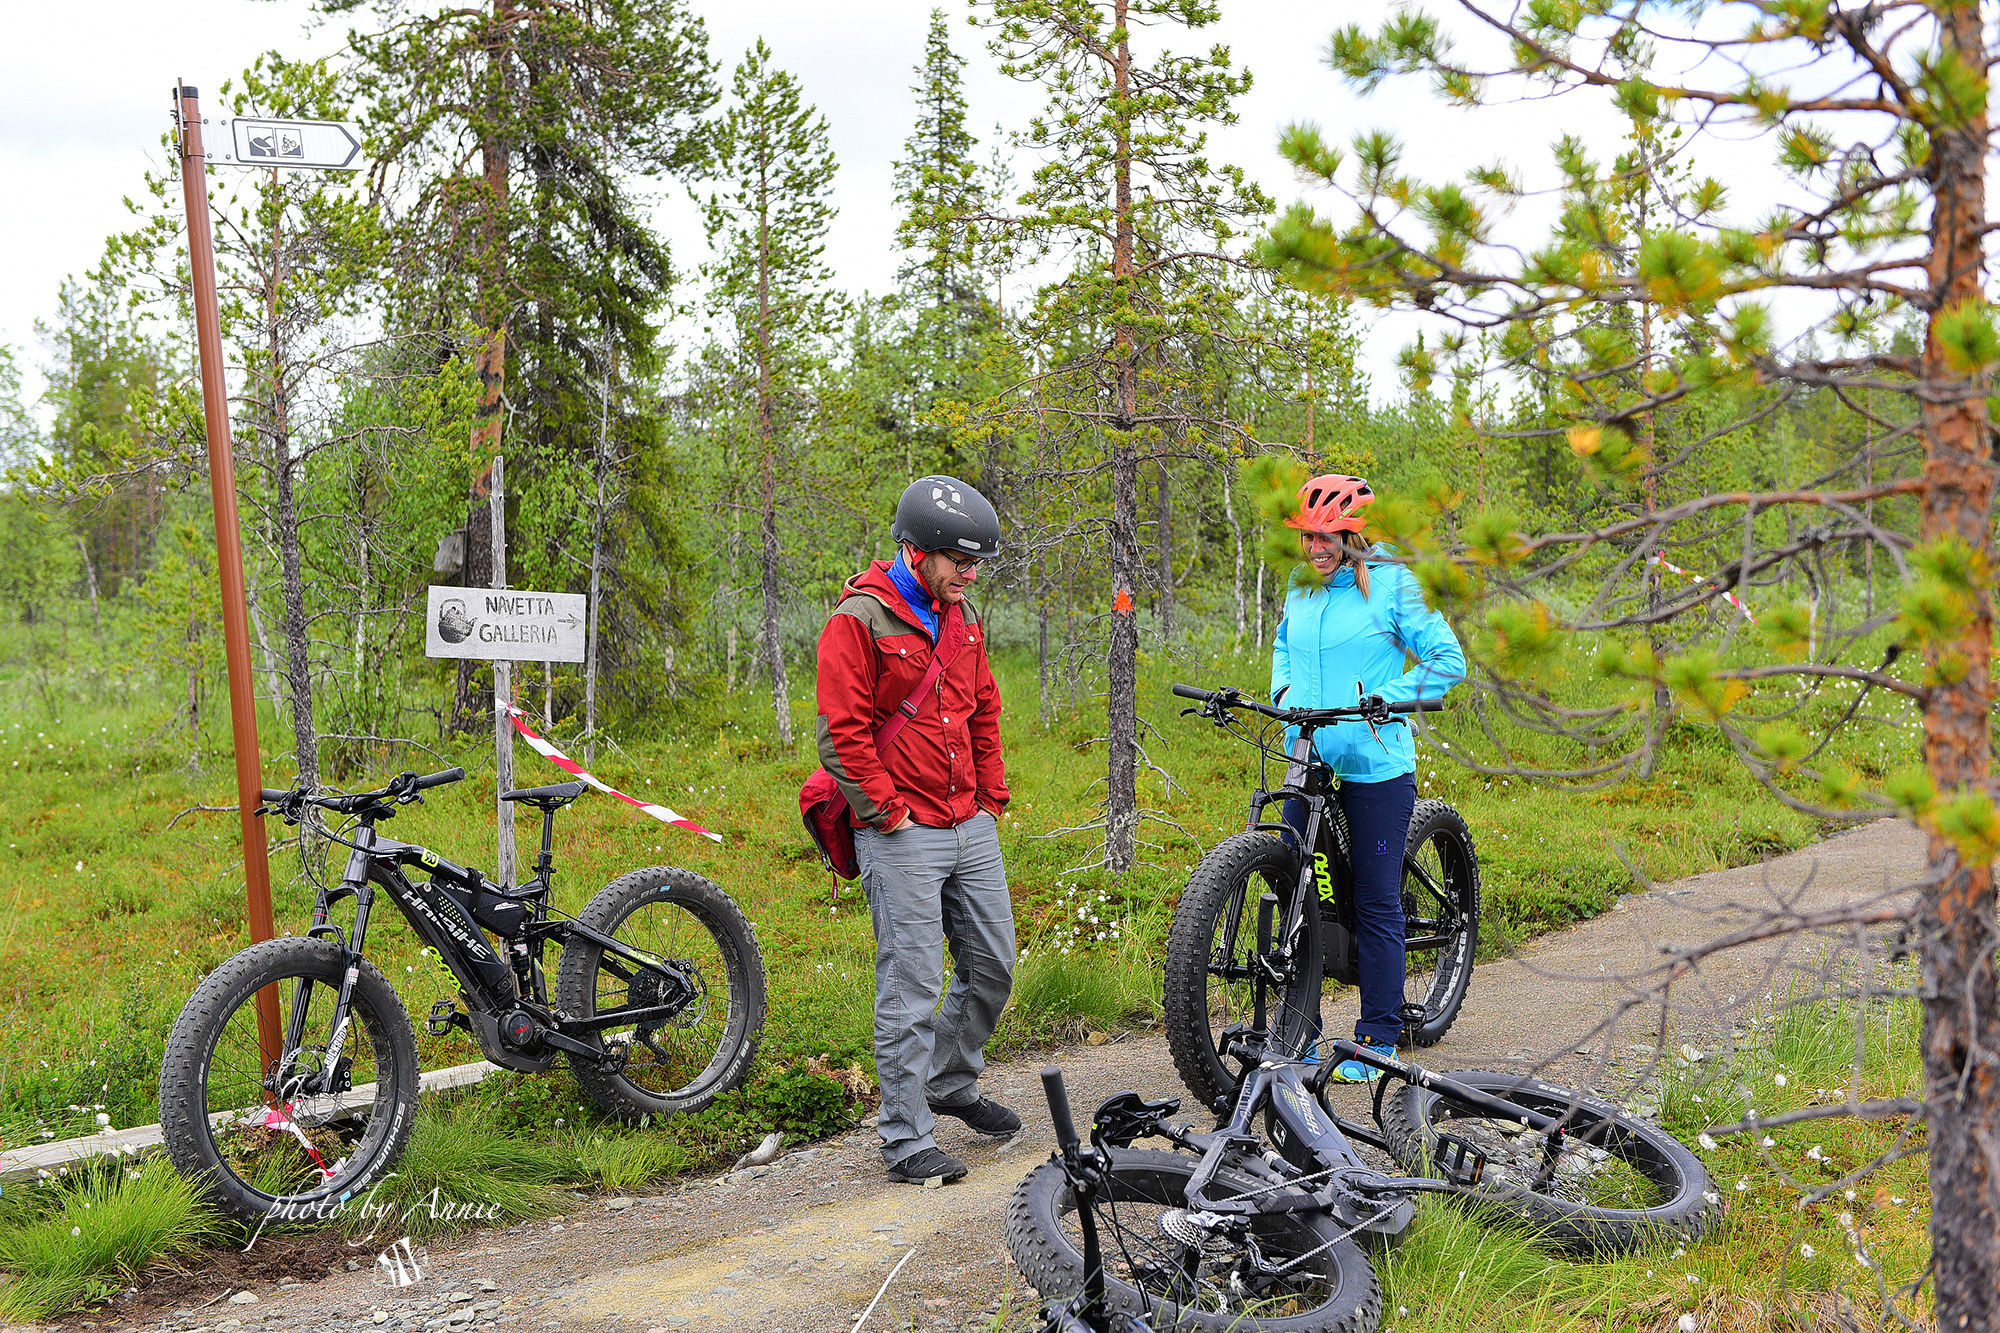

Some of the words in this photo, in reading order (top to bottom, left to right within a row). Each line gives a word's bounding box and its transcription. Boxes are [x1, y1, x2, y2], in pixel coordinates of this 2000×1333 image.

[485, 595, 555, 616] NAVETTA
[479, 623, 558, 645] GALLERIA
[1313, 852, 1336, 904] XDURO
[401, 890, 491, 960] HAIBIKE
